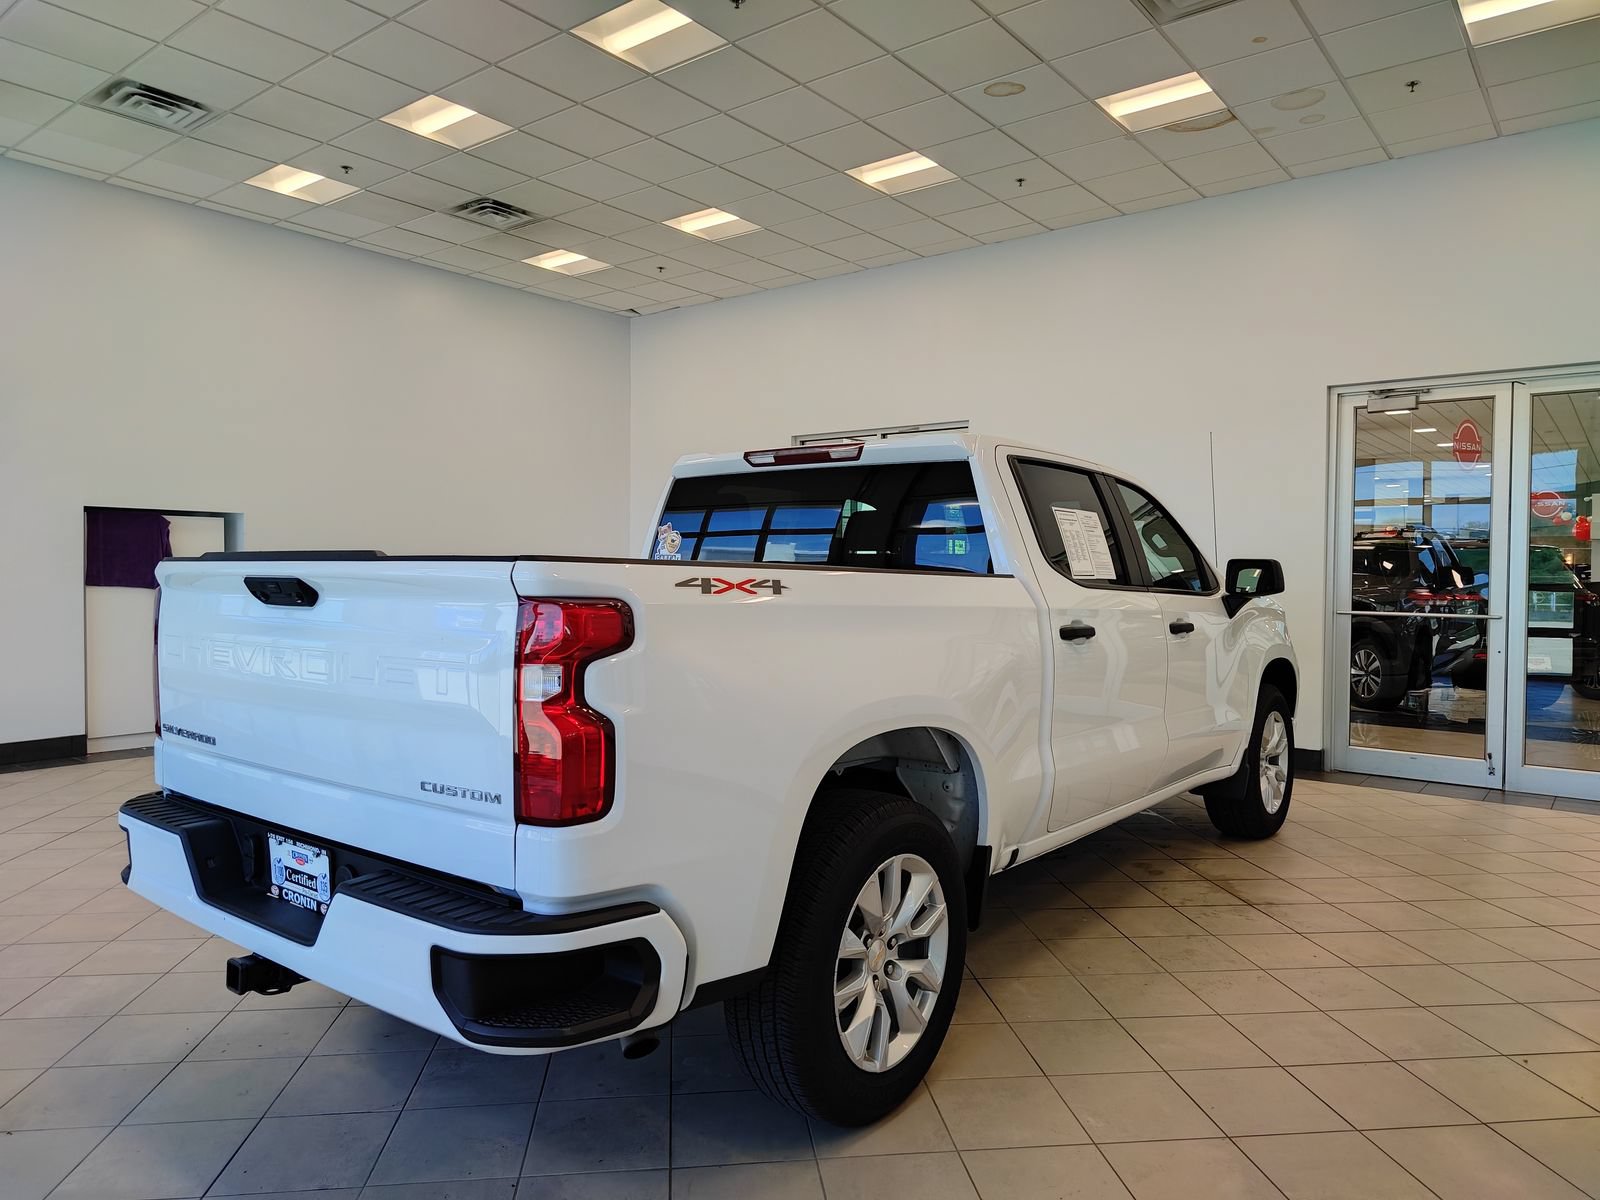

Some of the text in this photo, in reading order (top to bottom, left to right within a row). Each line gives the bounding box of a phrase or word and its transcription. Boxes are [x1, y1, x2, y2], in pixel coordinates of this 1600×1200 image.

[1452, 441, 1481, 452] NISSAN
[162, 723, 216, 746] SILVERADO
[420, 781, 502, 804] CUSTOM
[286, 868, 317, 890] Certified
[282, 888, 317, 911] CRONIN
